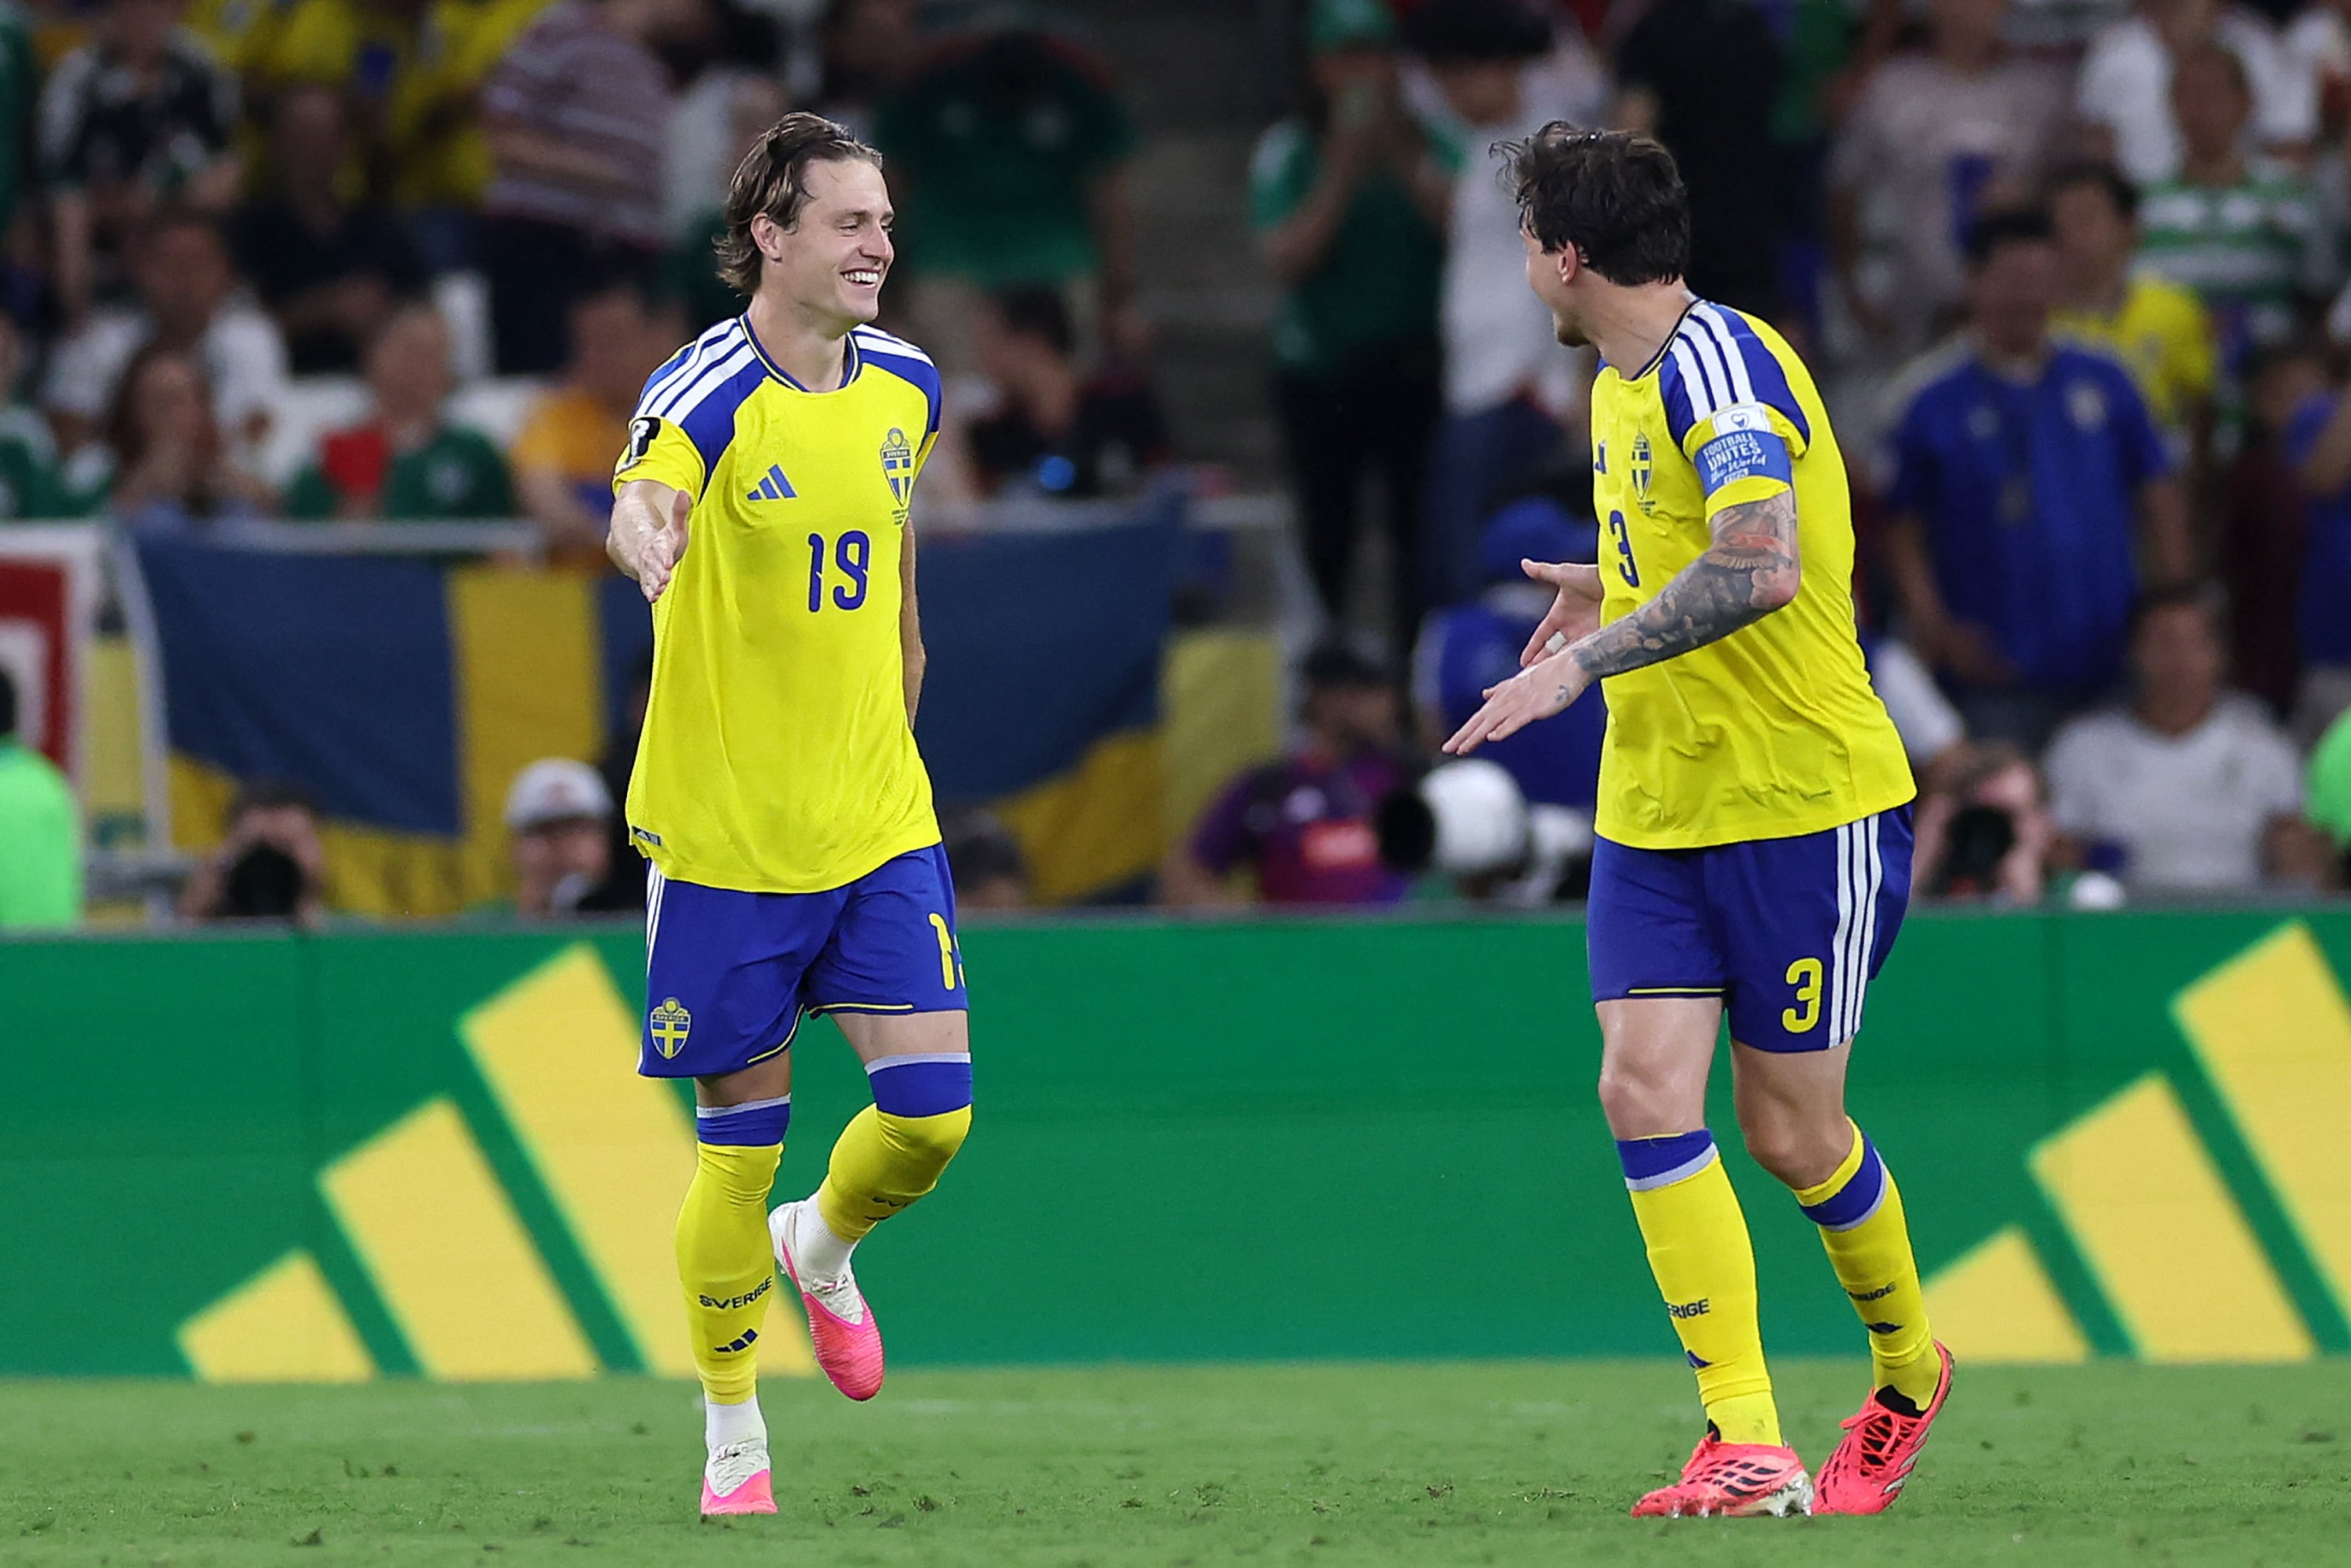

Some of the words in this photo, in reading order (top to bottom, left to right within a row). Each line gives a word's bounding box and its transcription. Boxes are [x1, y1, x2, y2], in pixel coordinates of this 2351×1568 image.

[1703, 432, 1754, 459] FOOTBALL
[1707, 442, 1761, 471] UNITES
[807, 530, 870, 613] 19
[1609, 510, 1640, 588] 3
[928, 912, 966, 990] 1
[1781, 956, 1823, 1034] 3
[698, 1275, 772, 1310] SVERIGE
[1667, 1298, 1711, 1319] RIGE
